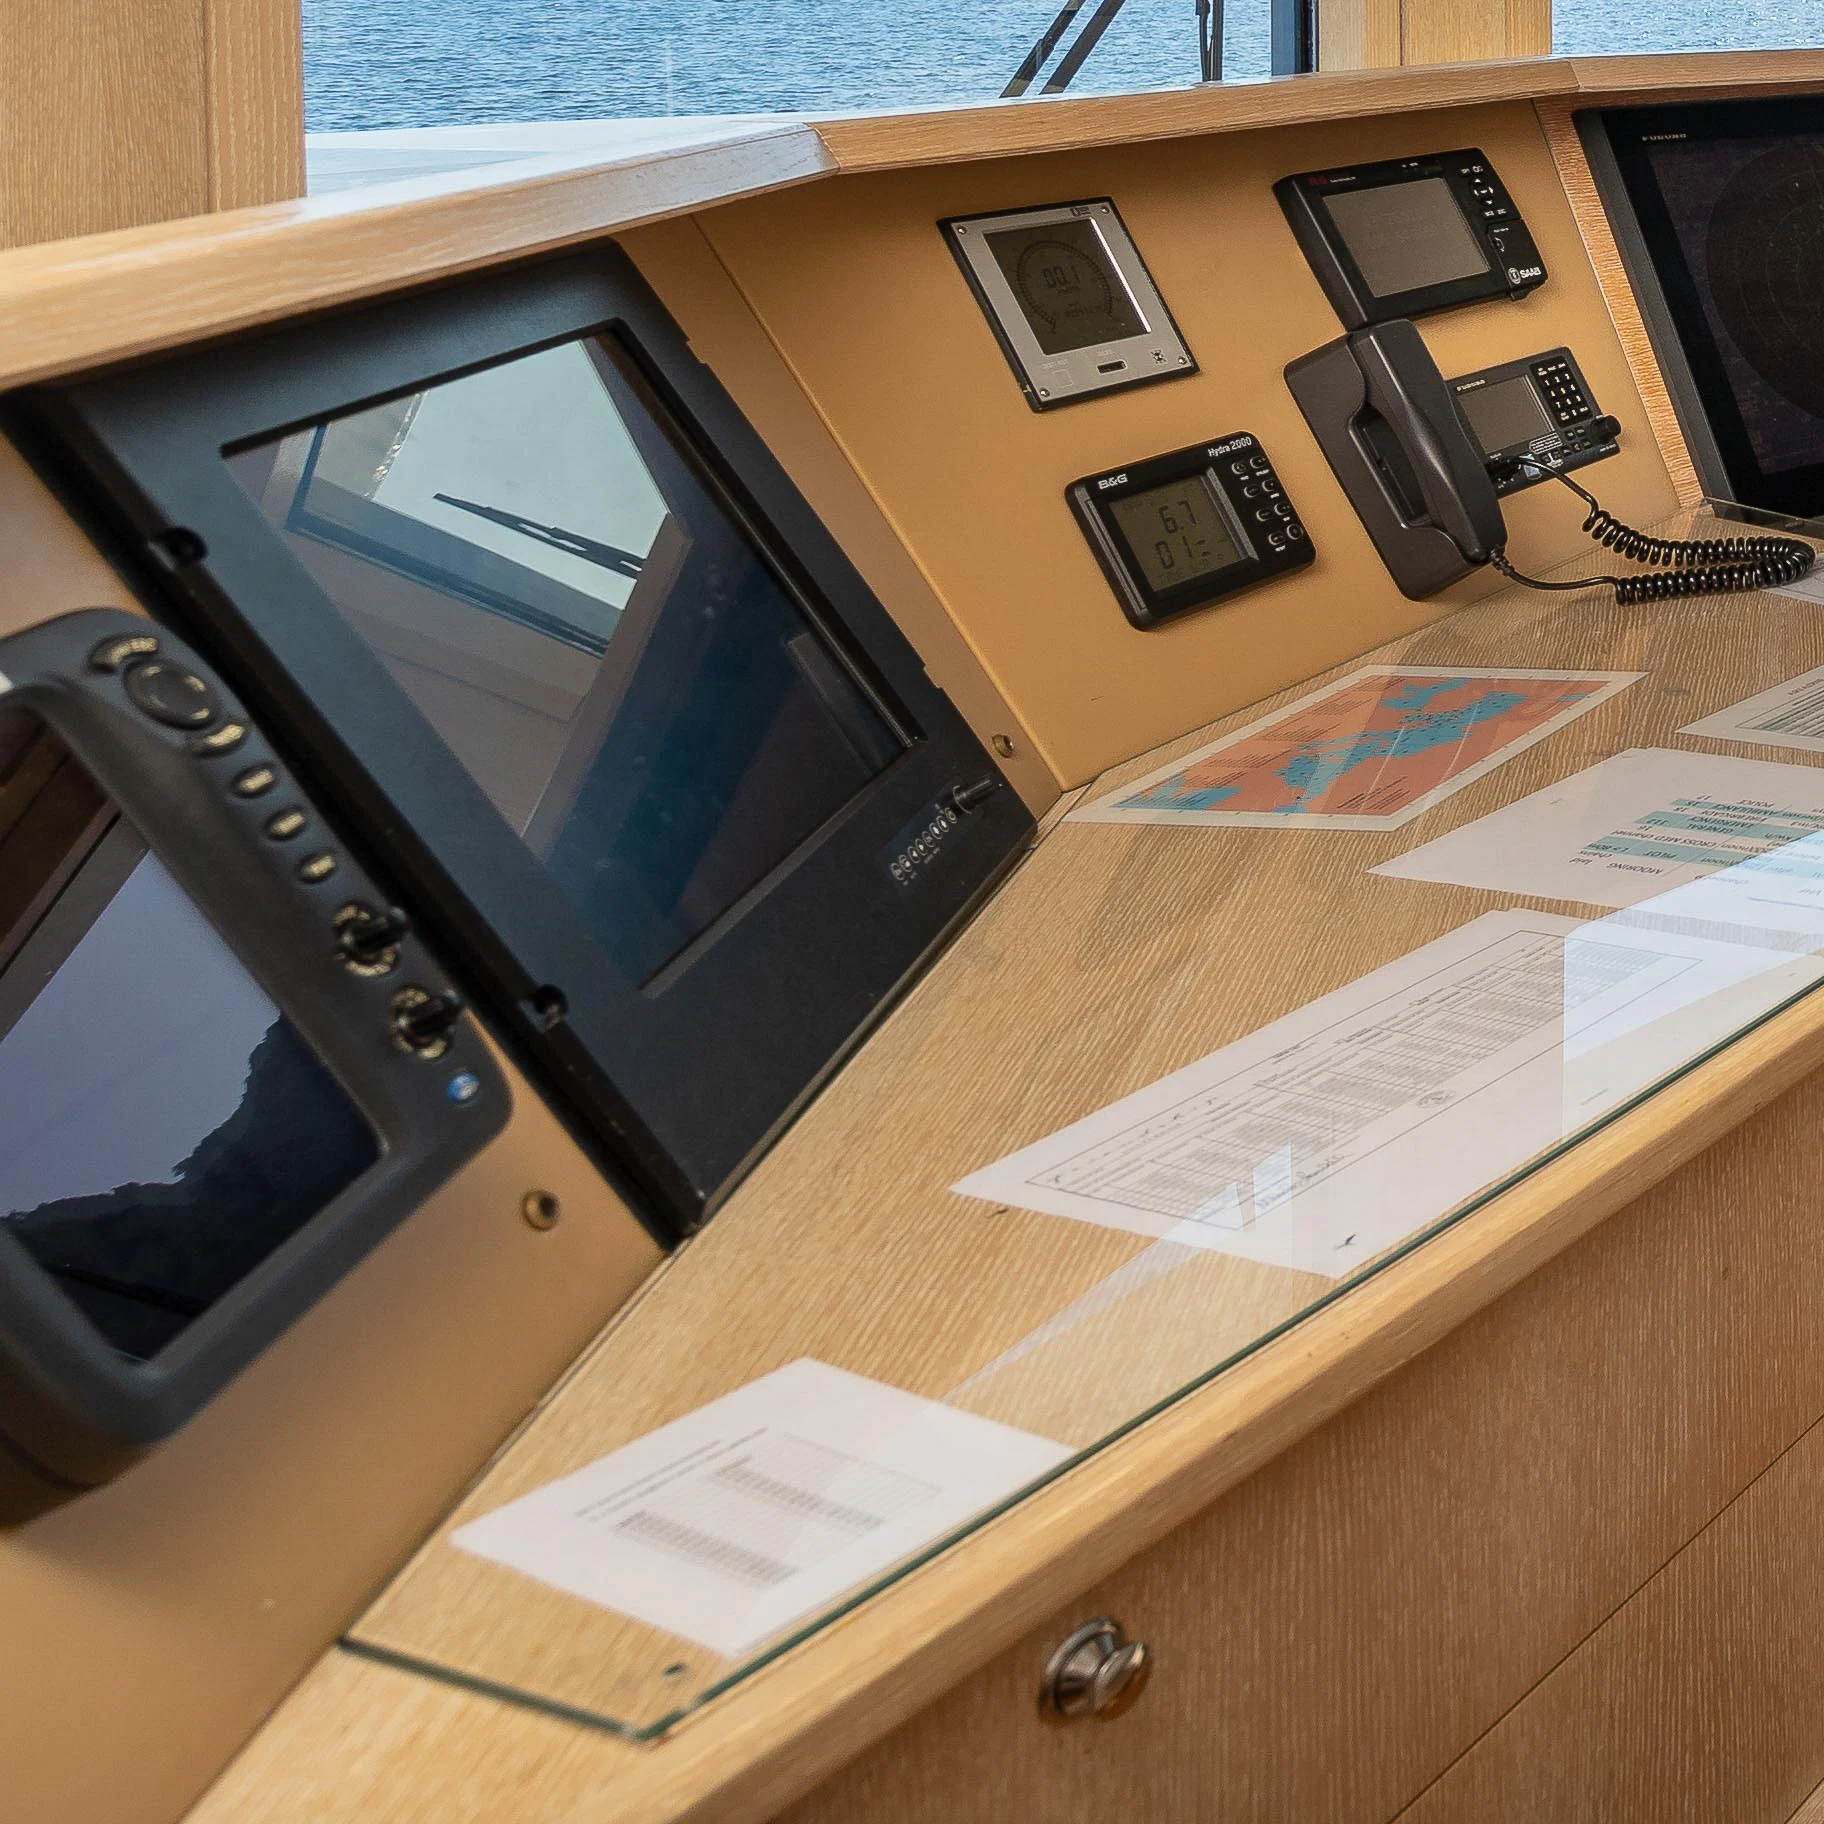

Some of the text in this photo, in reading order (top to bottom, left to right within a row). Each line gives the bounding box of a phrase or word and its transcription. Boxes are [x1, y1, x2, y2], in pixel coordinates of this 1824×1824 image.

[1519, 266, 1542, 280] SAAB
[1098, 473, 1128, 490] B&G
[1688, 816, 1754, 828] EMERGENCY
[1687, 824, 1734, 834] GENERAL
[1680, 837, 1717, 847] CROSS
[1643, 851, 1678, 859] PILOT
[1606, 862, 1664, 875] MOORING
